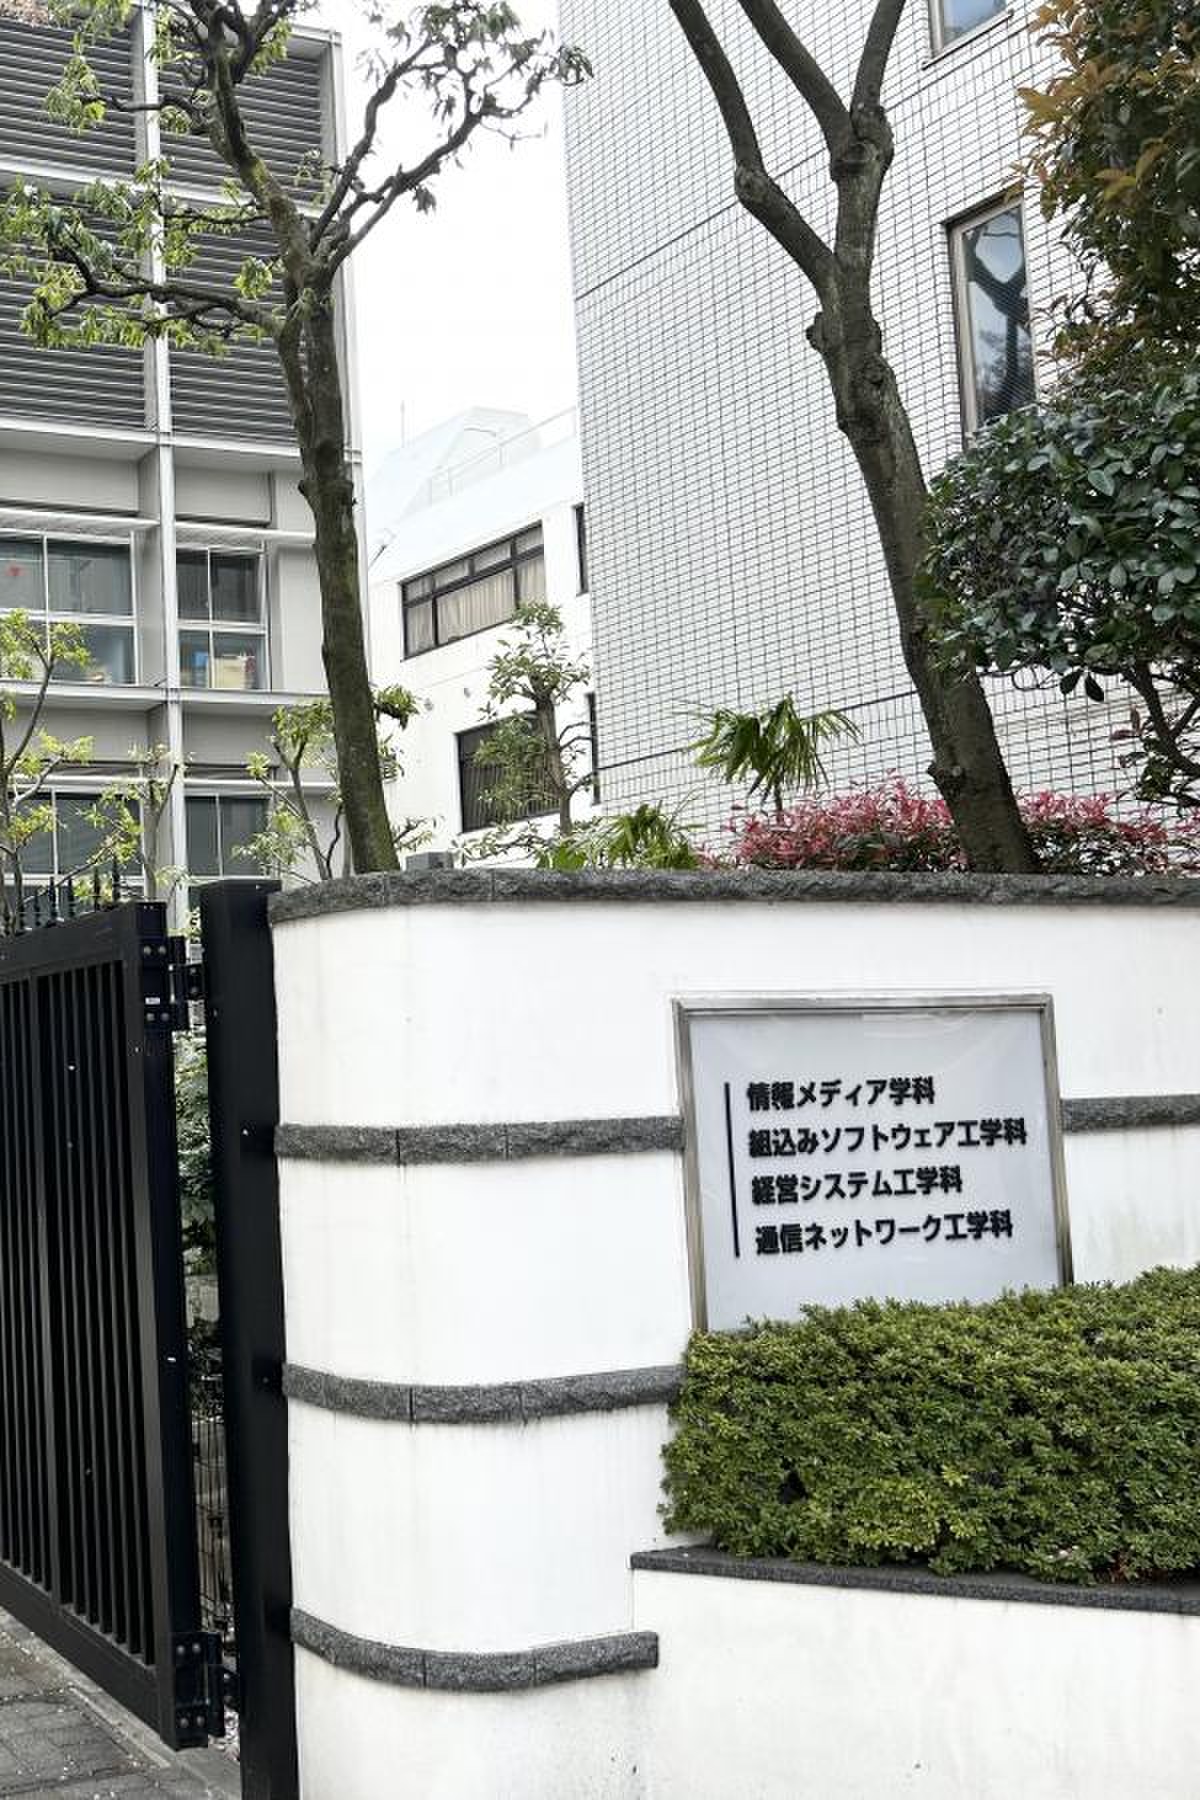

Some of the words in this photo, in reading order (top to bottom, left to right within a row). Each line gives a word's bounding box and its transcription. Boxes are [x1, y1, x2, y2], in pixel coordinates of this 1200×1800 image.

[747, 1076, 935, 1112] 情報メディア学科
[749, 1118, 1027, 1158] 組込みソフトウェア工学科
[752, 1165, 962, 1205] 経営システム工学科
[756, 1209, 1013, 1255] 通信ネットワーク工学科
